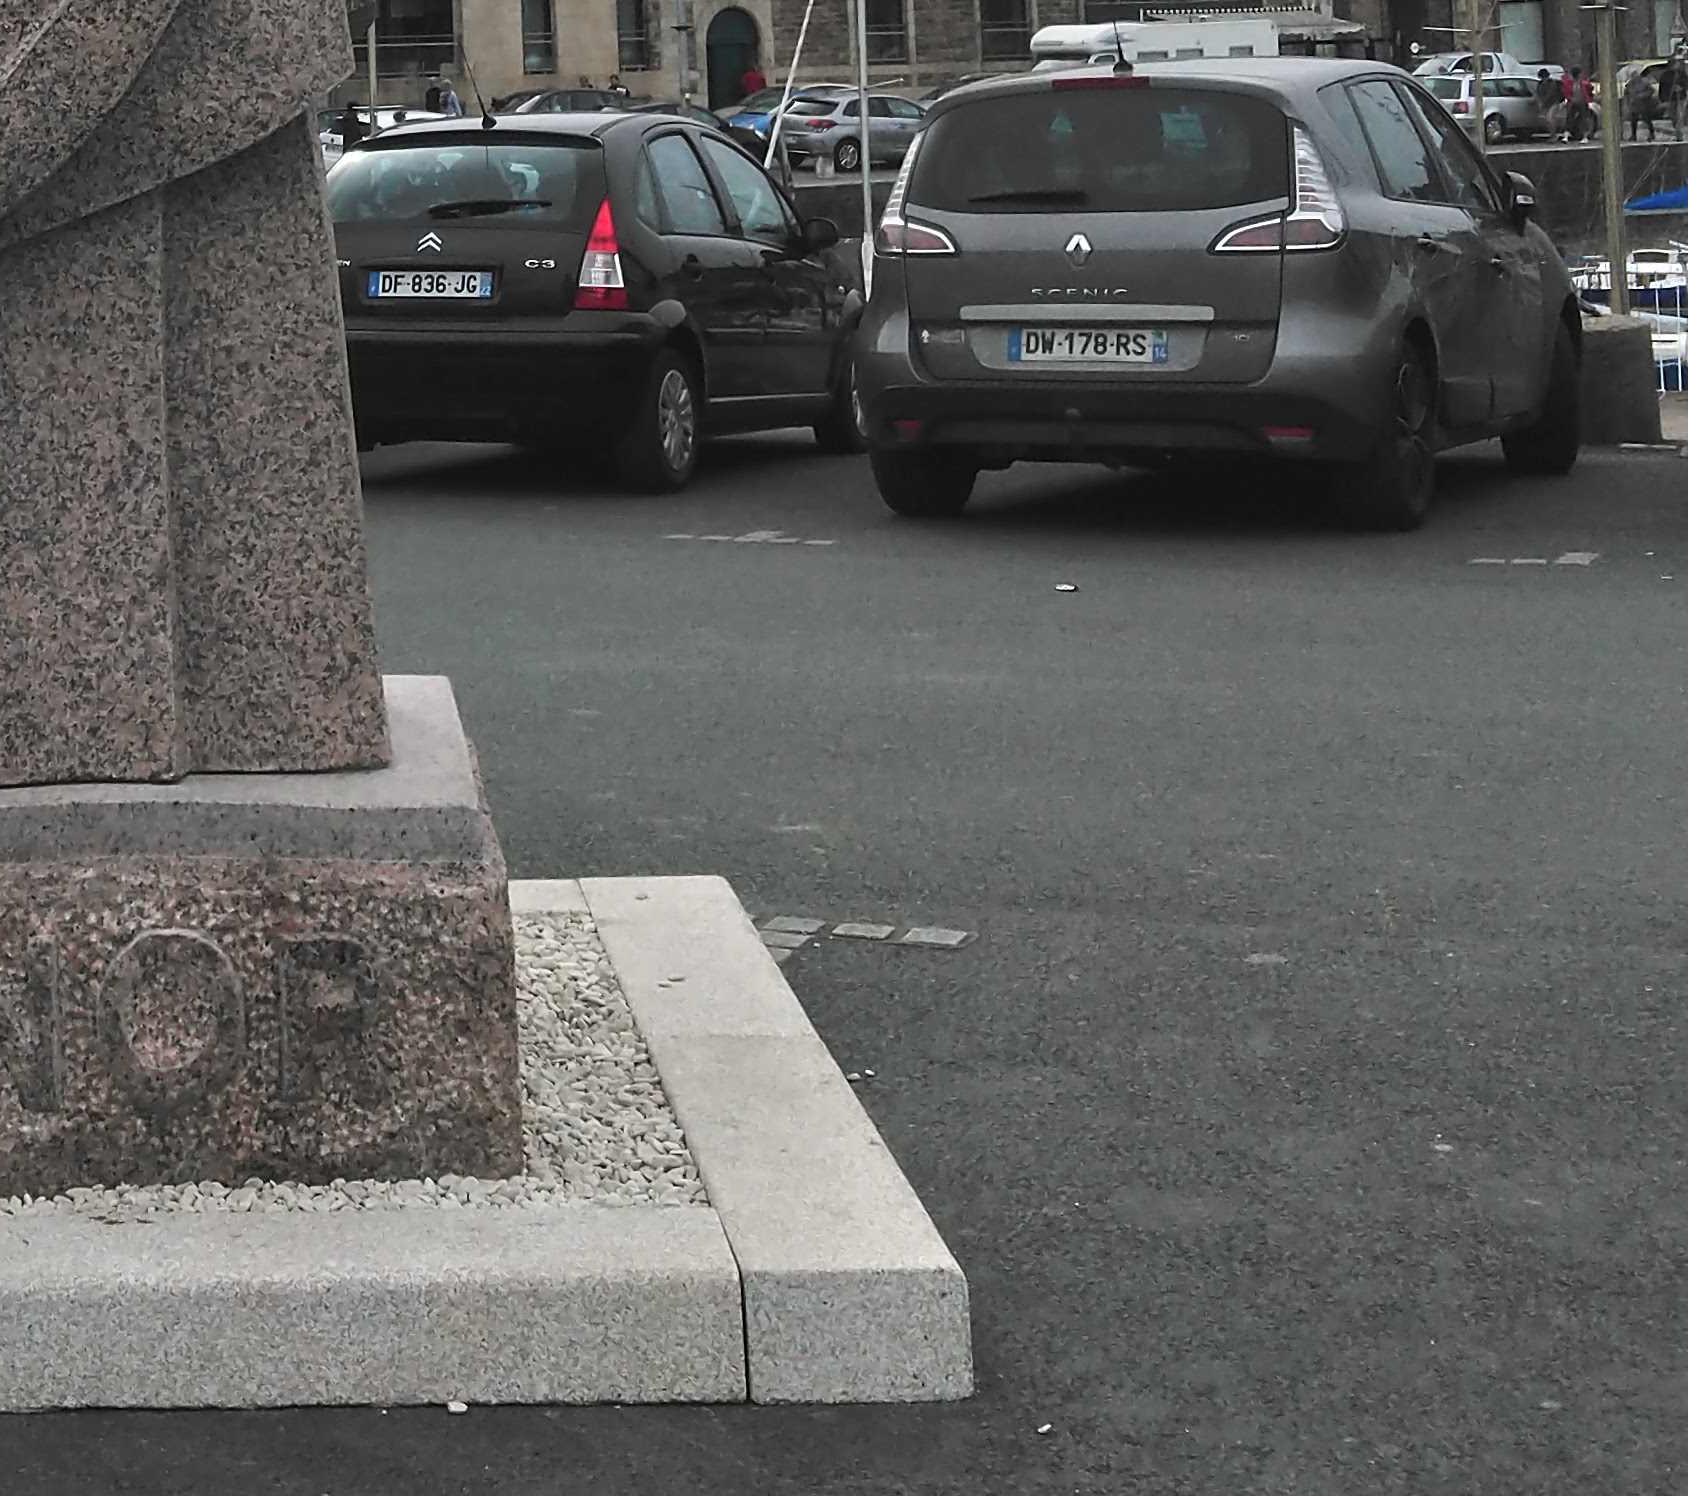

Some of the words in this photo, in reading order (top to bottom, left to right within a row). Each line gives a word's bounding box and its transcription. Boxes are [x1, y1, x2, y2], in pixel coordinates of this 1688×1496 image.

[524, 259, 556, 269] C3
[381, 274, 478, 294] DF-836-JG
[1025, 331, 1148, 356] DW-178-RS
